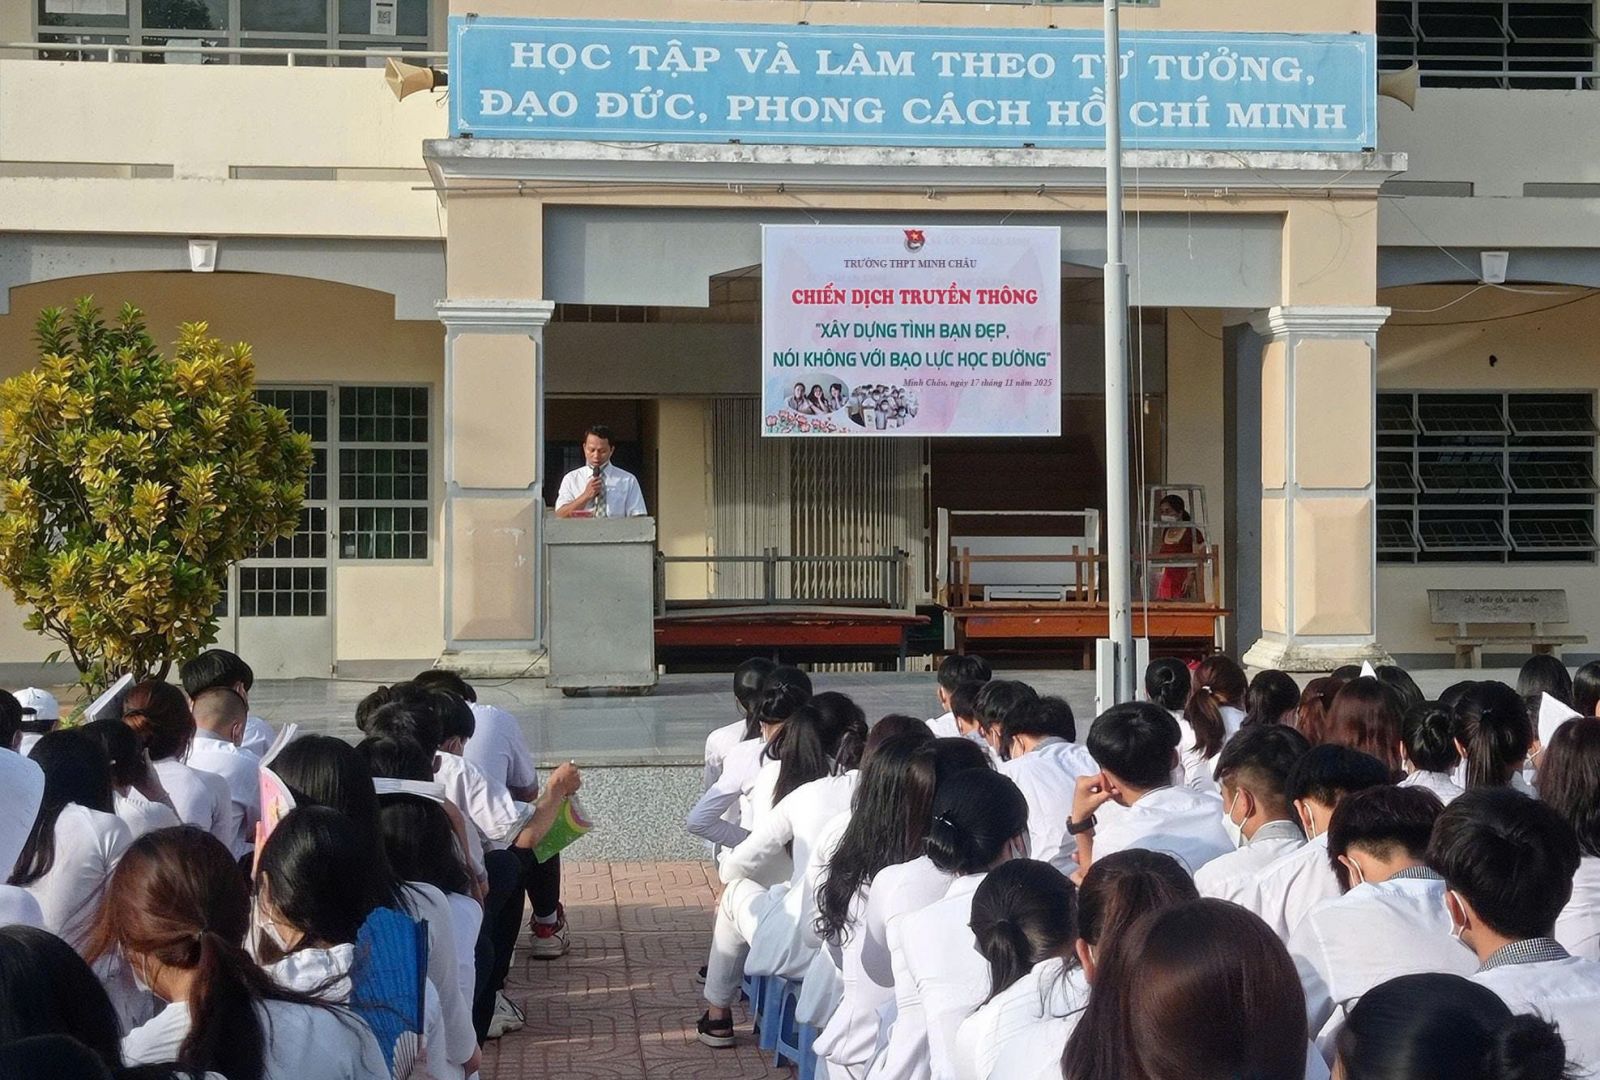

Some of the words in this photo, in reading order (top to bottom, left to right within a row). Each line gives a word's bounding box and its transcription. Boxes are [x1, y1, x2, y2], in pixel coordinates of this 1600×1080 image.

[510, 42, 612, 75] HỌC
[629, 39, 721, 77] TẬP
[735, 41, 800, 75] VÀ
[816, 43, 916, 77] LÀM
[932, 52, 1056, 79] THEO
[1148, 46, 1315, 86] TƯỞNG,
[480, 90, 579, 122] ĐẠO
[596, 86, 708, 124] ĐỨC,
[726, 95, 886, 125] PHONG
[903, 92, 1031, 126] CÁCH
[1047, 86, 1106, 127] HỒ
[1129, 95, 1210, 128] CHÍ
[1226, 103, 1347, 130] MINH
[844, 257, 887, 268] TRƯỜNG
[890, 259, 916, 268] THPT
[918, 259, 946, 268] MINH
[948, 257, 977, 268] CHÂU
[791, 282, 846, 305] CHIẾN
[851, 289, 895, 309] DỊCH
[899, 281, 971, 305] TRUYỀN
[976, 285, 1038, 305] THÔNG
[816, 320, 850, 338] "XÂY
[853, 321, 897, 341] DỰNG
[901, 320, 935, 338] TÌNH
[940, 323, 971, 341] BẠN
[773, 348, 799, 367] NÓI
[804, 348, 857, 367] KHÔNG
[860, 348, 886, 367] VỚI
[890, 352, 922, 371] BẠO
[925, 350, 954, 371] LỰC
[958, 352, 988, 371] HỌC
[992, 348, 1051, 367] ĐƯỜNG"
[903, 378, 924, 387] Minh
[950, 378, 968, 388] ngày
[970, 378, 980, 387] 17
[981, 378, 1003, 388] tháng
[1005, 378, 1014, 387] 11
[1015, 378, 1032, 387] năm
[1034, 378, 1053, 387] 2025
